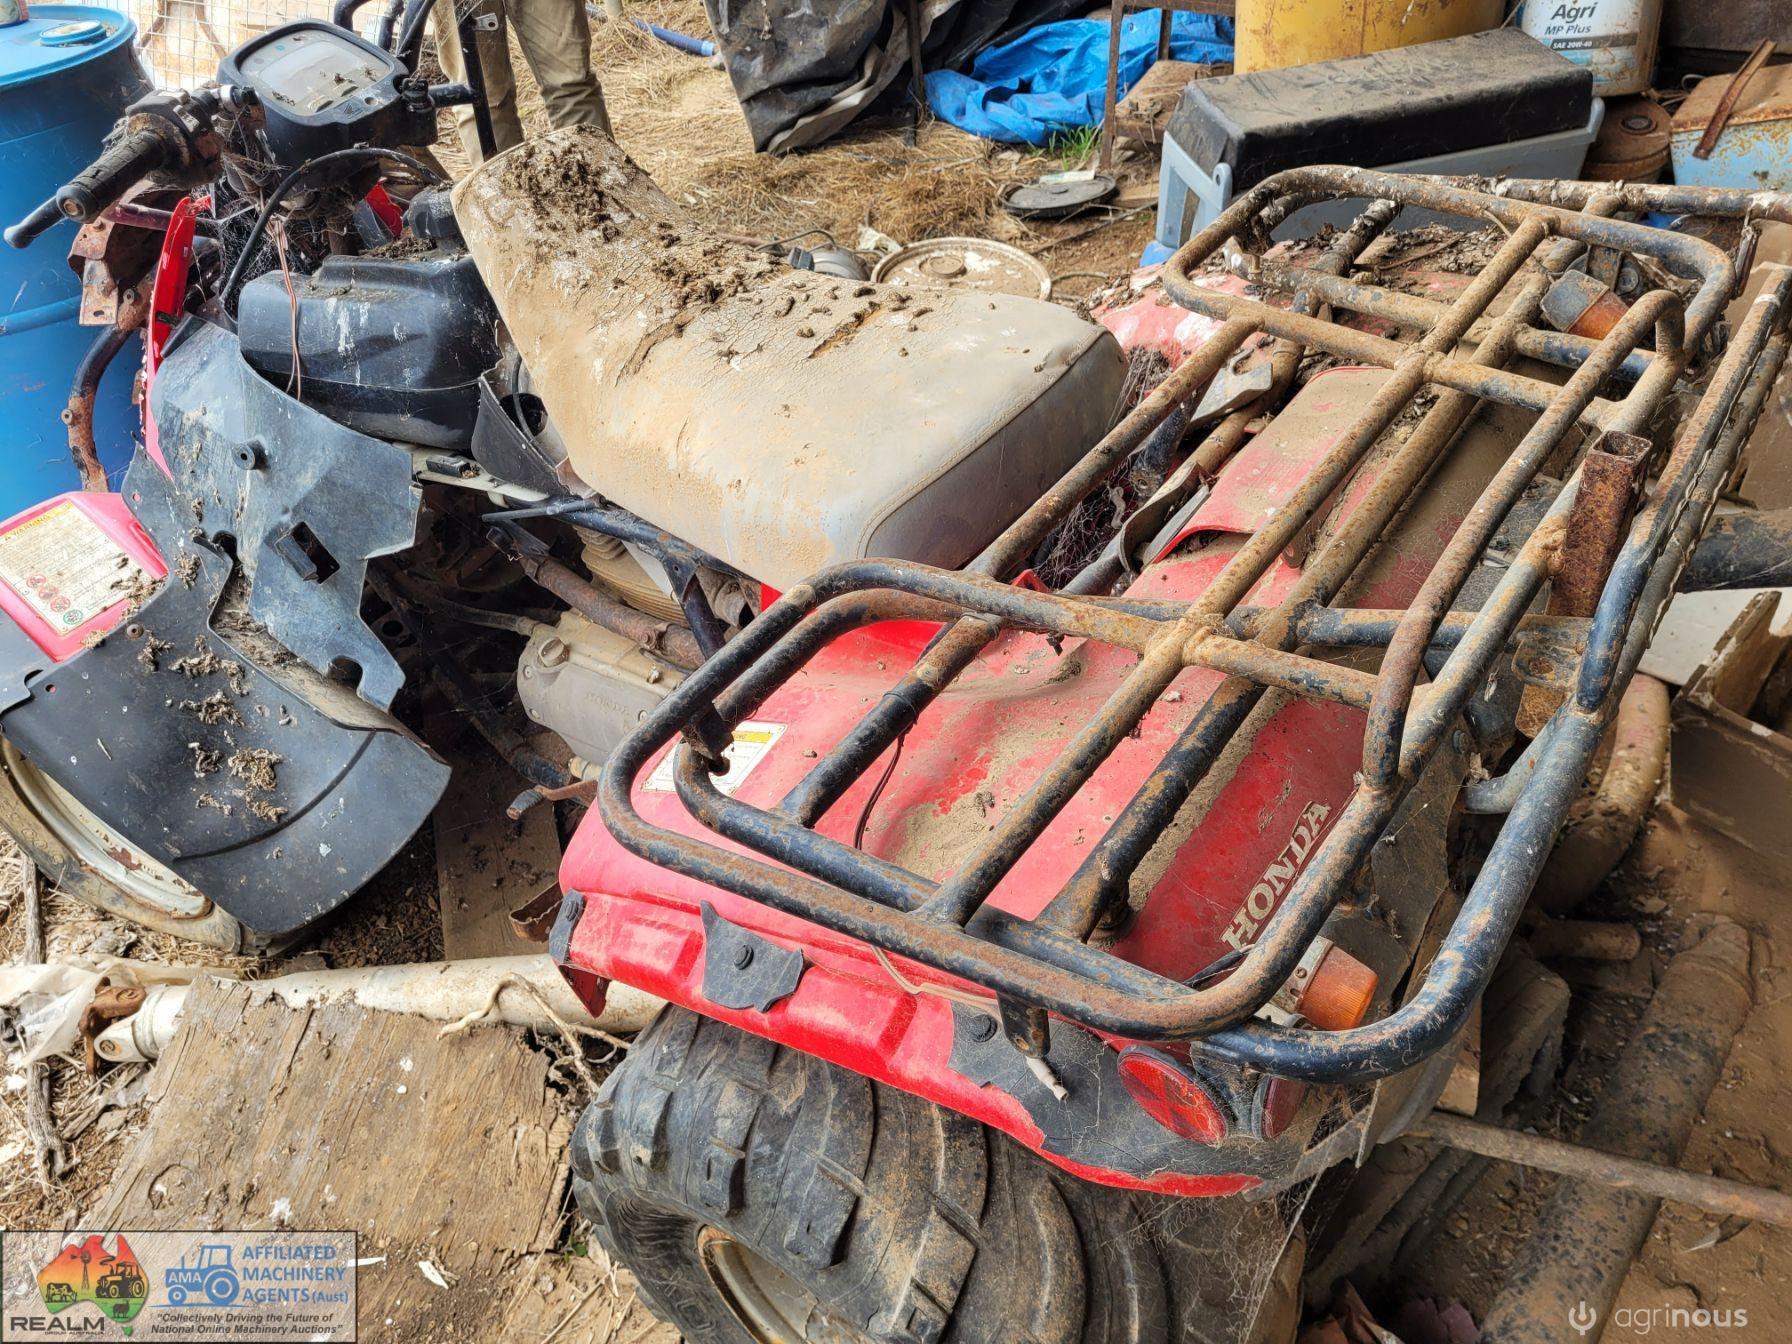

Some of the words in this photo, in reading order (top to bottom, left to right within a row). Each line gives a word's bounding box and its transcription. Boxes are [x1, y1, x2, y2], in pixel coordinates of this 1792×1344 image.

[1551, 2, 1598, 23] Agri
[1544, 26, 1564, 35] MP
[1566, 24, 1592, 34] Plus
[1552, 41, 1566, 49] SAE
[1221, 802, 1332, 950] HONDA
